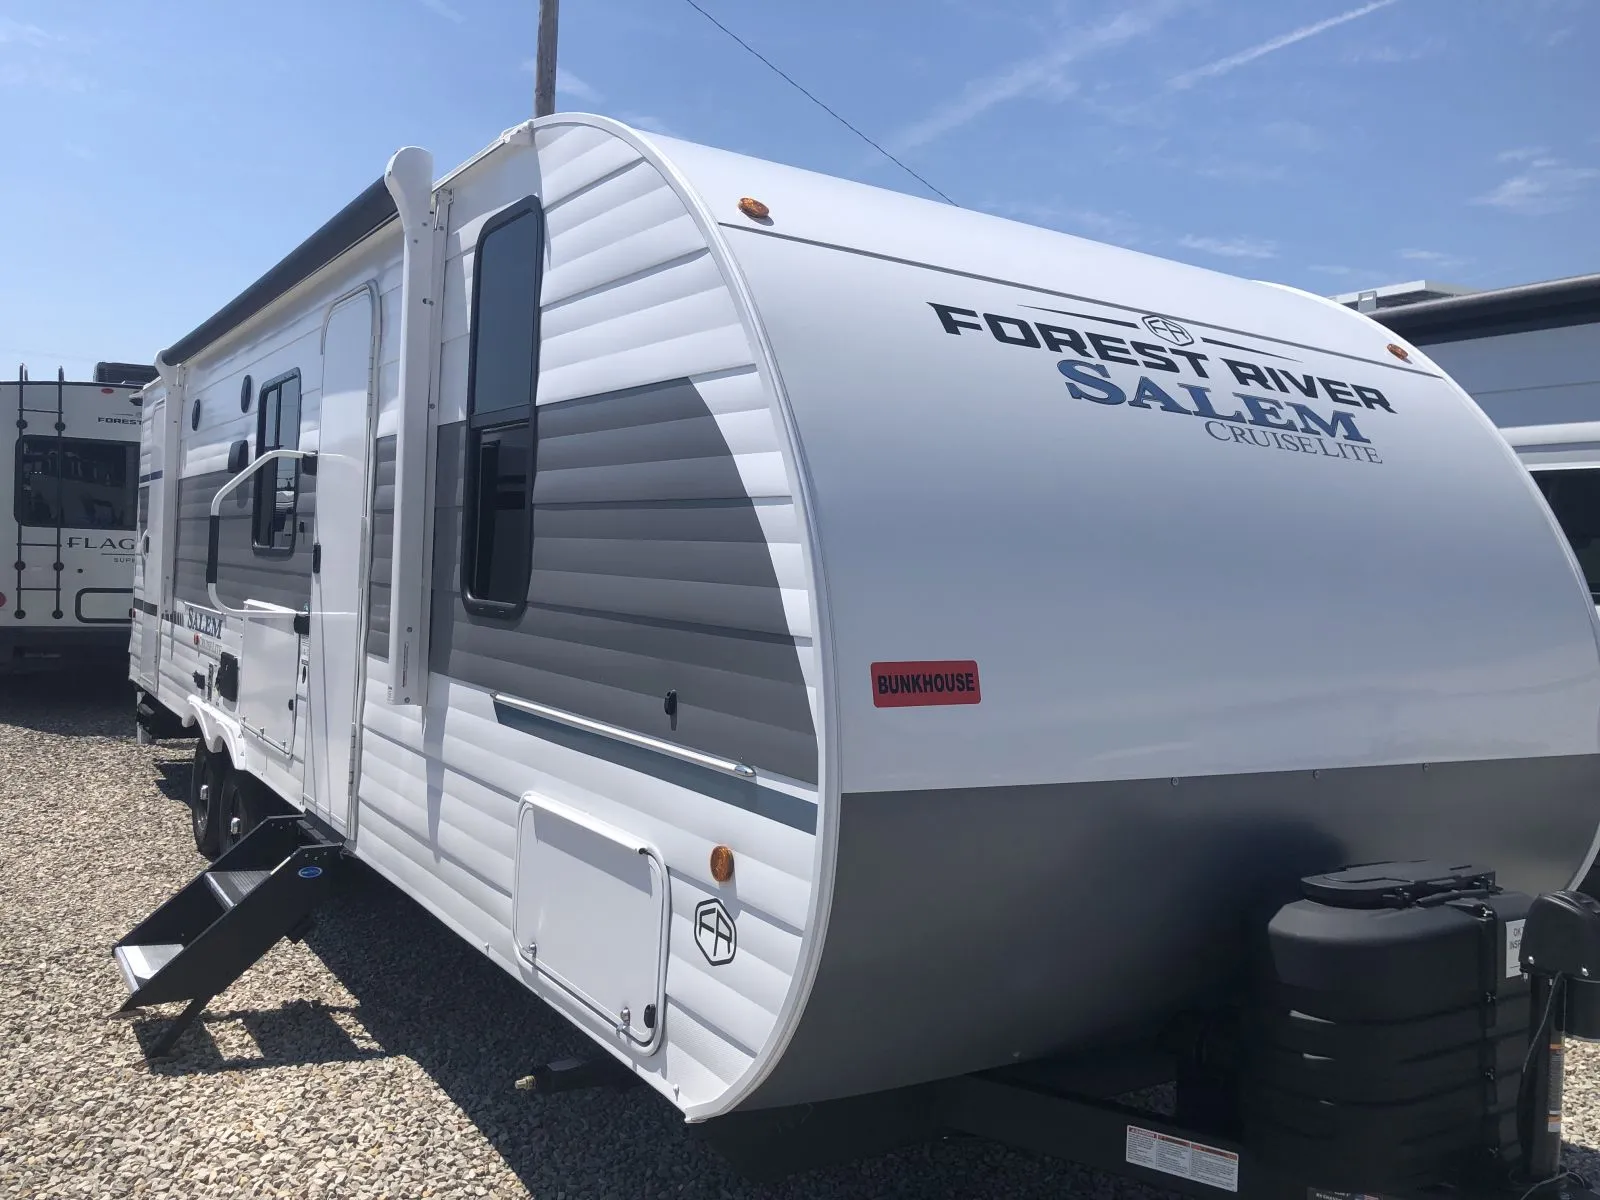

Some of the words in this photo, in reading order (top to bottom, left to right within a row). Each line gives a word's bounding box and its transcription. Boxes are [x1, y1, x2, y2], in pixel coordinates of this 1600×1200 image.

[926, 302, 1210, 379] FOREST
[1220, 357, 1399, 414] RIVER
[1057, 359, 1372, 443] SALEM
[98, 416, 141, 425] FOREST
[1204, 420, 1383, 464] CRUISELITE
[188, 607, 223, 639] SALEM
[877, 673, 975, 695] BUNKHOUSE
